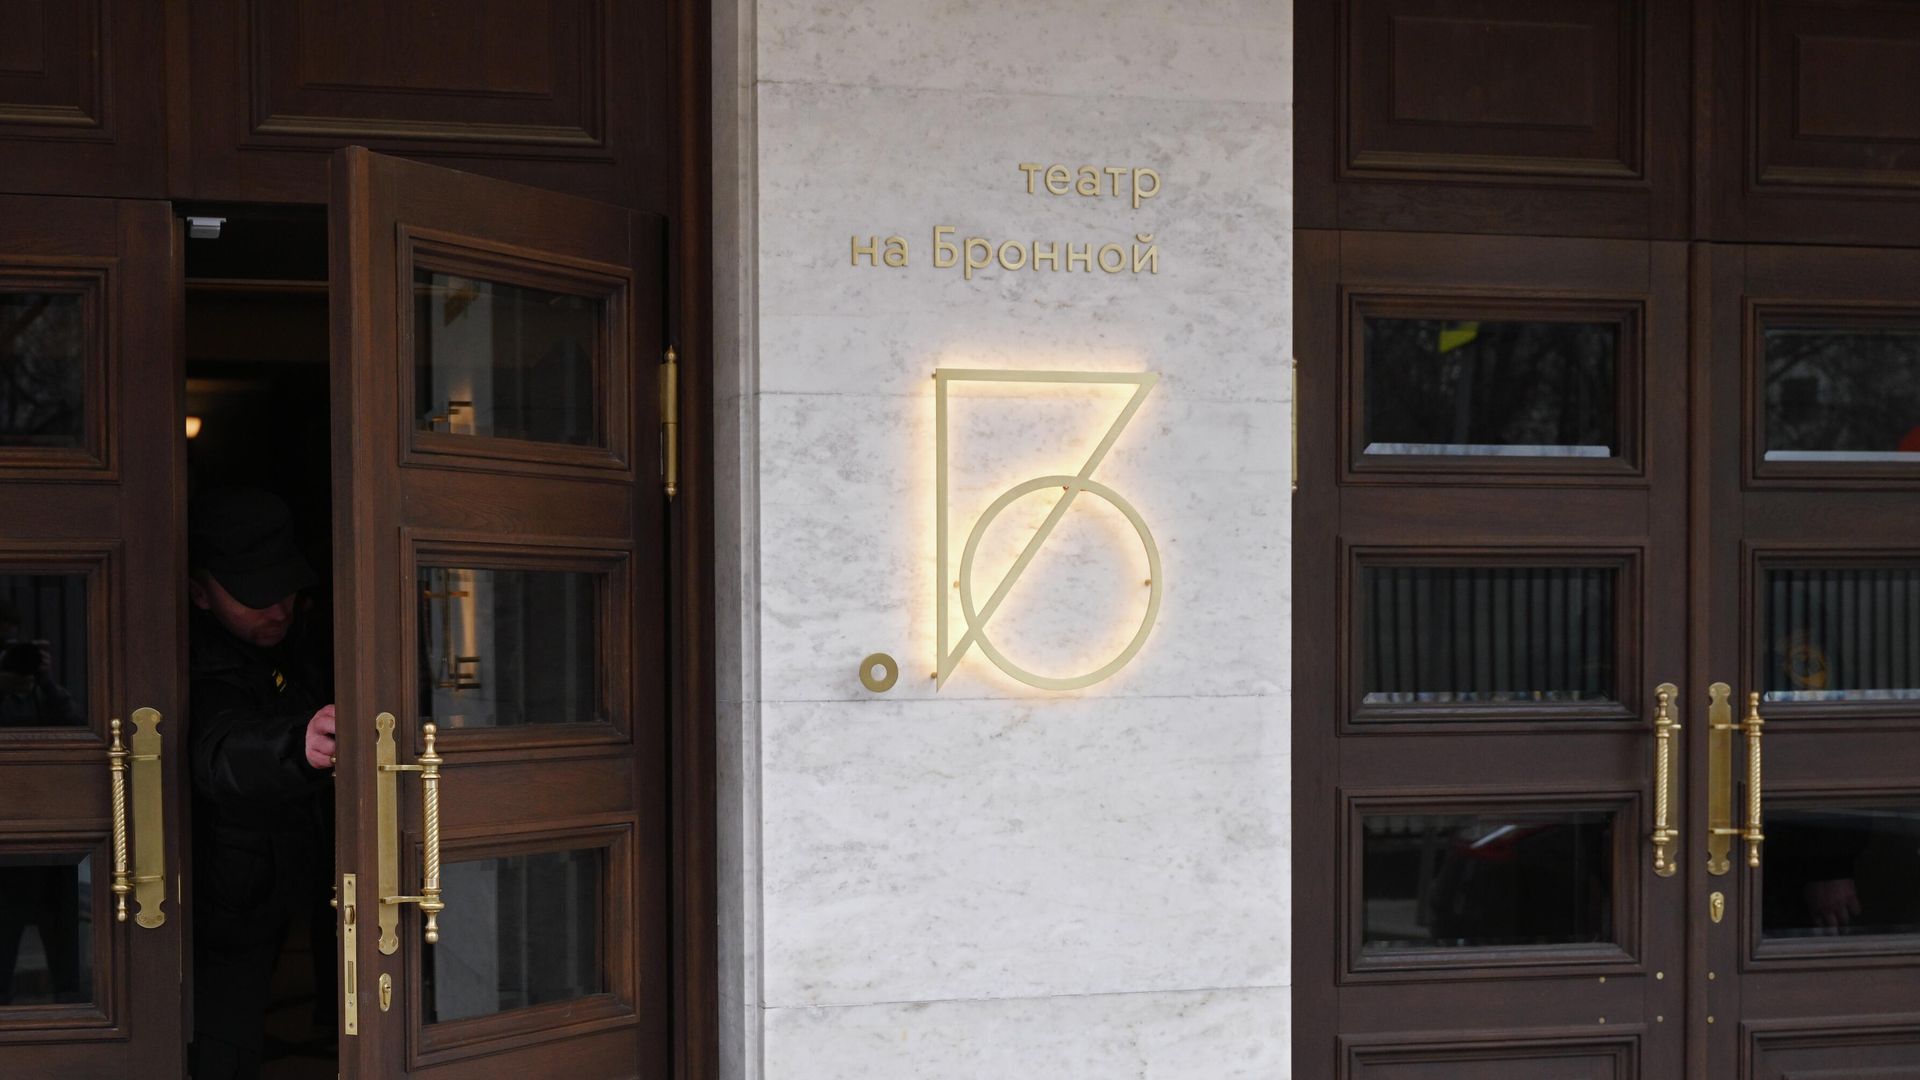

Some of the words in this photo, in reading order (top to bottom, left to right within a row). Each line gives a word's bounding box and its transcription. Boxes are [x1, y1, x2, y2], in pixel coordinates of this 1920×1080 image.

[1019, 163, 1161, 209] театр
[851, 235, 909, 268] на
[933, 224, 1159, 281] Бронной
